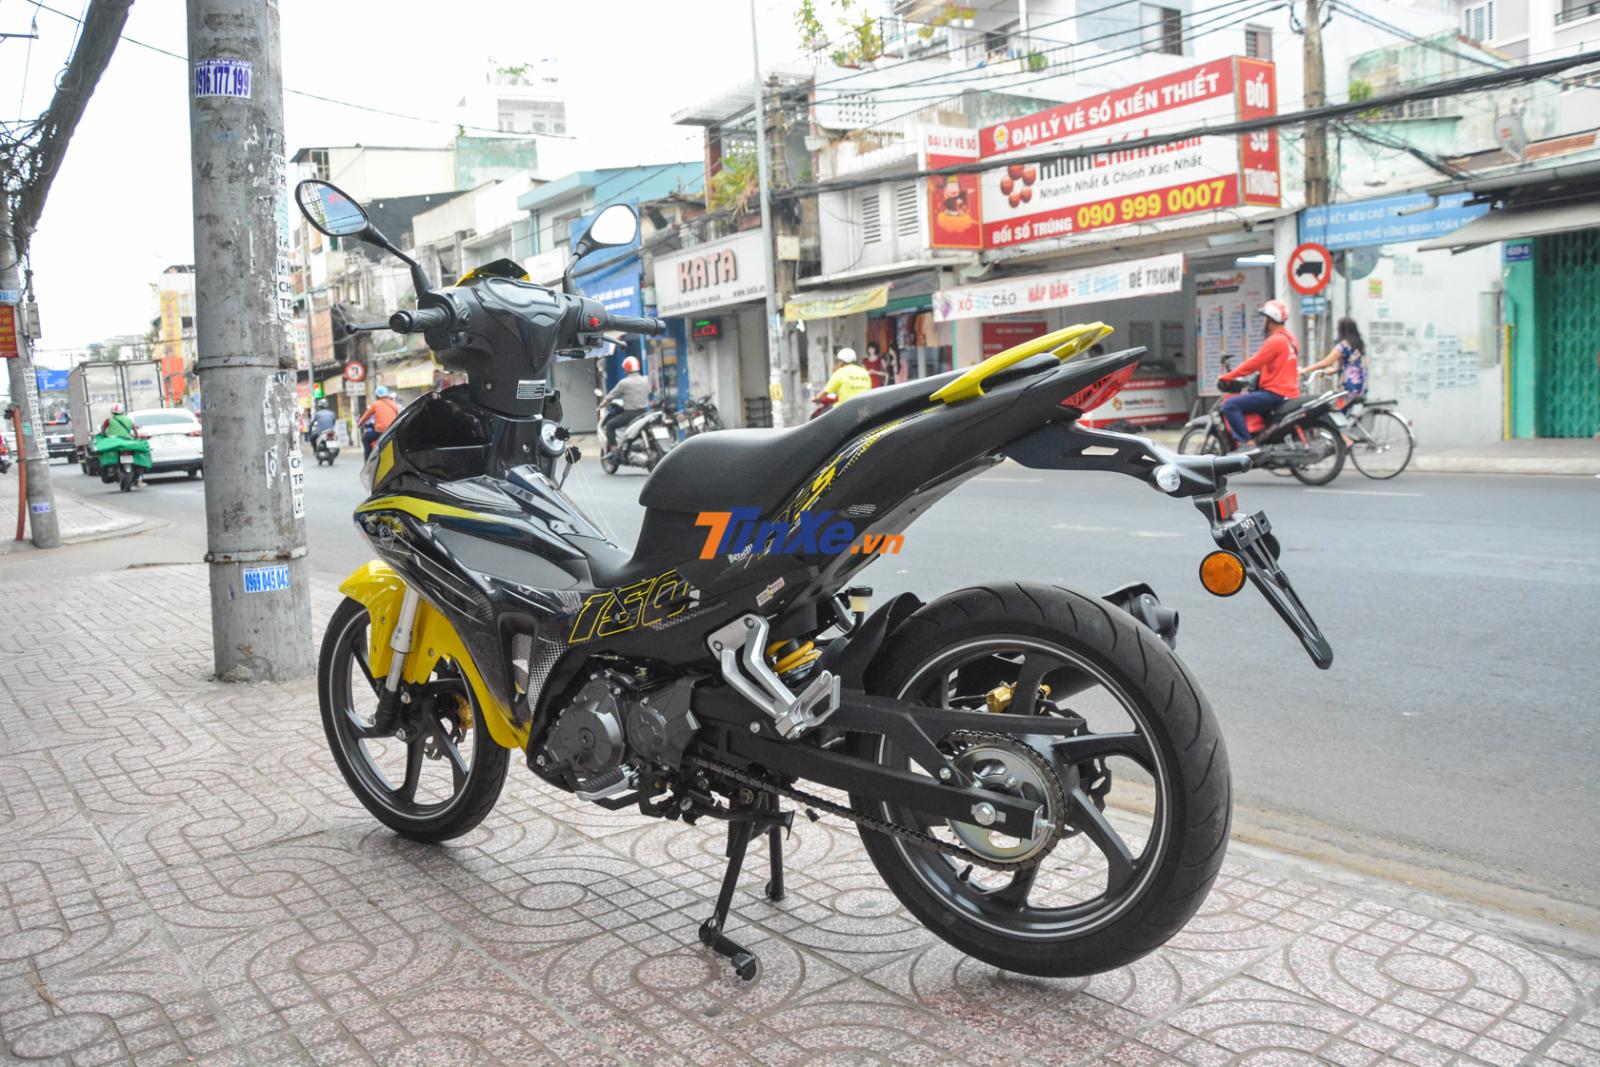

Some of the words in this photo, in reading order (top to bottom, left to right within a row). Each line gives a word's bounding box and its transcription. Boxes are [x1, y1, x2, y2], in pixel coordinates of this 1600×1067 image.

[1012, 124, 1038, 146] ĐẠI
[1040, 113, 1060, 135] LÝ
[1063, 109, 1086, 131] VÉ
[1088, 97, 1111, 125] SỐ
[1113, 87, 1159, 119] KIẾN
[1161, 68, 1220, 106] THIẾT
[1040, 183, 1072, 200] Nhanh
[1074, 176, 1099, 193] Nhất
[1102, 173, 1110, 187] &
[1113, 167, 1146, 184] Chính
[1149, 160, 1170, 177] Xác
[1174, 153, 1203, 171] Nhất
[1014, 219, 1031, 240] SỐ
[1033, 213, 1073, 236] TRÚNG
[1077, 201, 1117, 229] 090
[1120, 191, 1162, 221] 999
[1167, 179, 1227, 212] 0007
[677, 248, 738, 293] KATA
